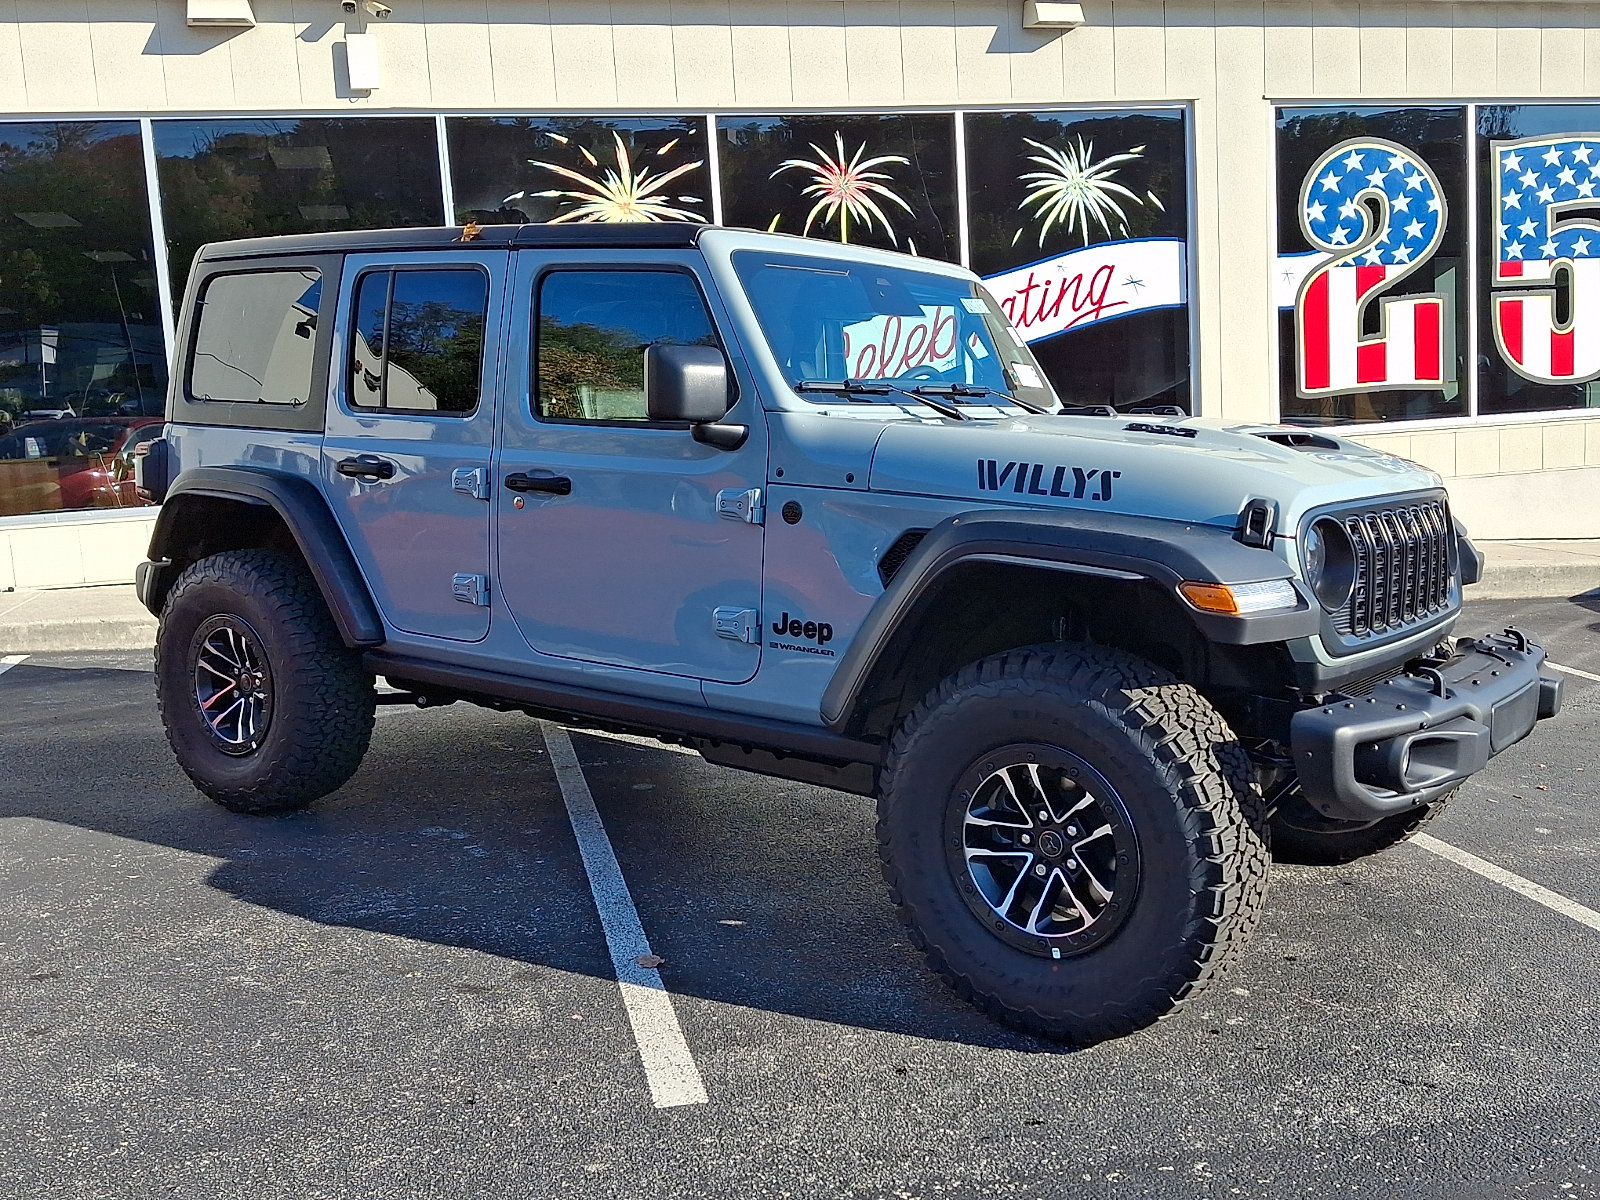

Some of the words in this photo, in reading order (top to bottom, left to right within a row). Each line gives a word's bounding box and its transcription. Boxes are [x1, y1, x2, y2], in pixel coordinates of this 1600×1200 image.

[978, 459, 1121, 502] WILLYS
[772, 612, 833, 645] Jeep
[779, 642, 834, 656] WRANGLER
